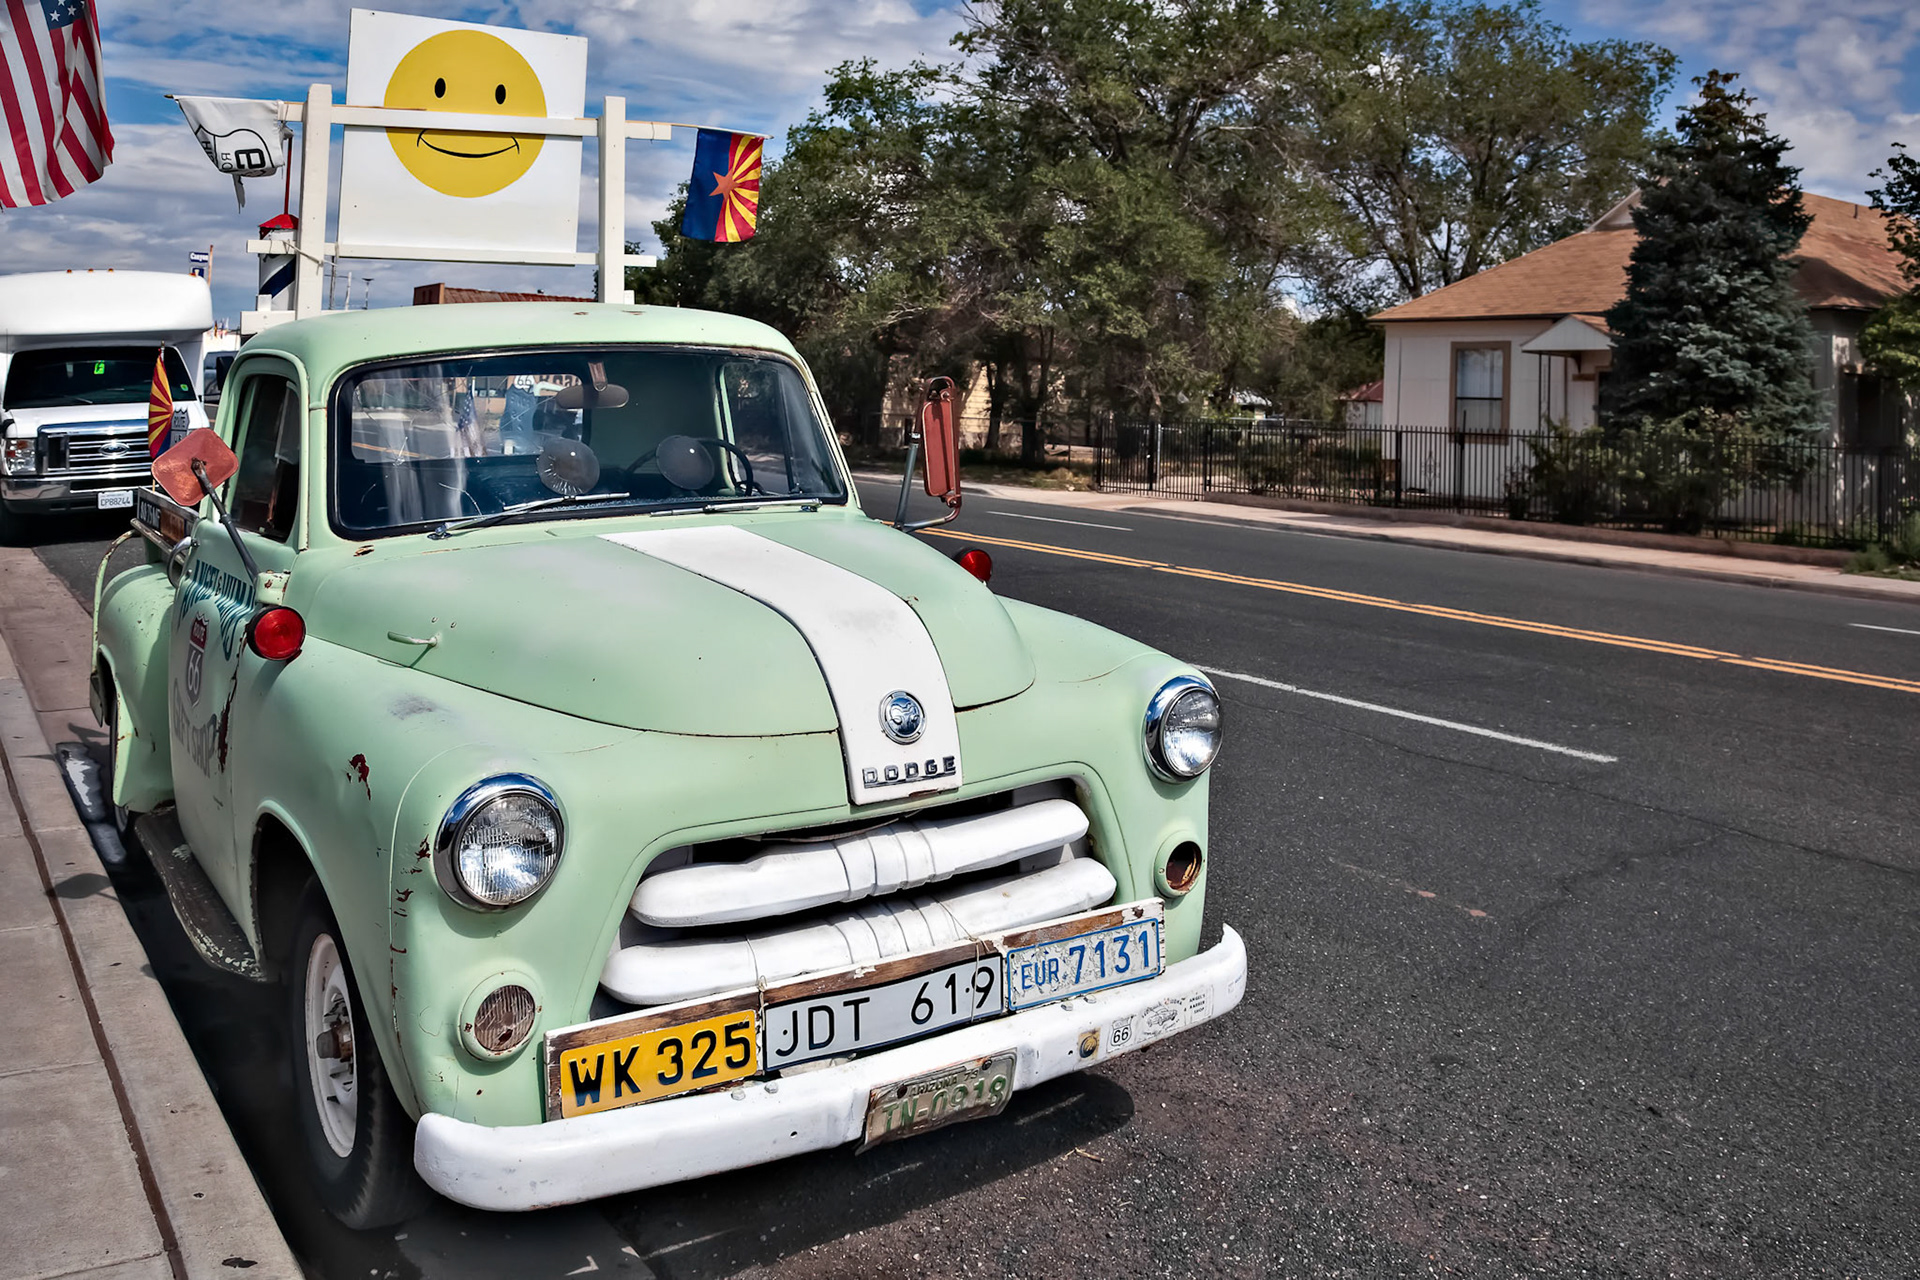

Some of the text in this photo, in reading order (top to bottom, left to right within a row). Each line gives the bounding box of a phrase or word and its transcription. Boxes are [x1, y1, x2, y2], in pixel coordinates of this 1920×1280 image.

[187, 649, 203, 696] 66
[861, 756, 957, 785] DODGE
[1020, 929, 1151, 990] EUR 7131
[775, 965, 995, 1058] JDT 619
[1113, 1026, 1129, 1043] 66
[568, 1020, 751, 1108] WK 325
[910, 1074, 958, 1096] ARIZONA
